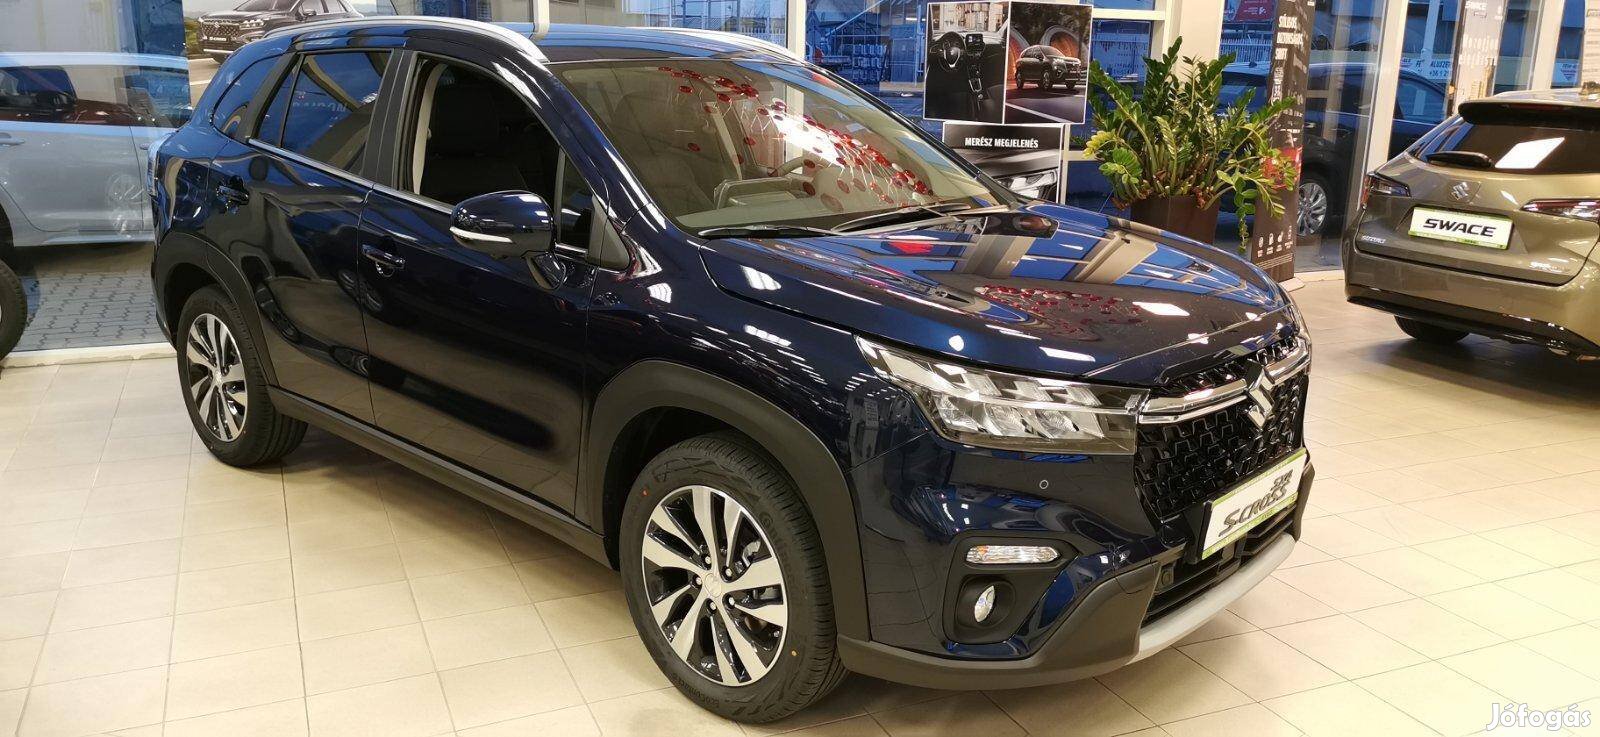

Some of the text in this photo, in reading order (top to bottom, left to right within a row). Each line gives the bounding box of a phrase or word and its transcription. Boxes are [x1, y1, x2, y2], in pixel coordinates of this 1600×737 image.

[964, 137, 1039, 149] MERÉSZ MEGJELENÉS
[1423, 218, 1497, 237] SWACE
